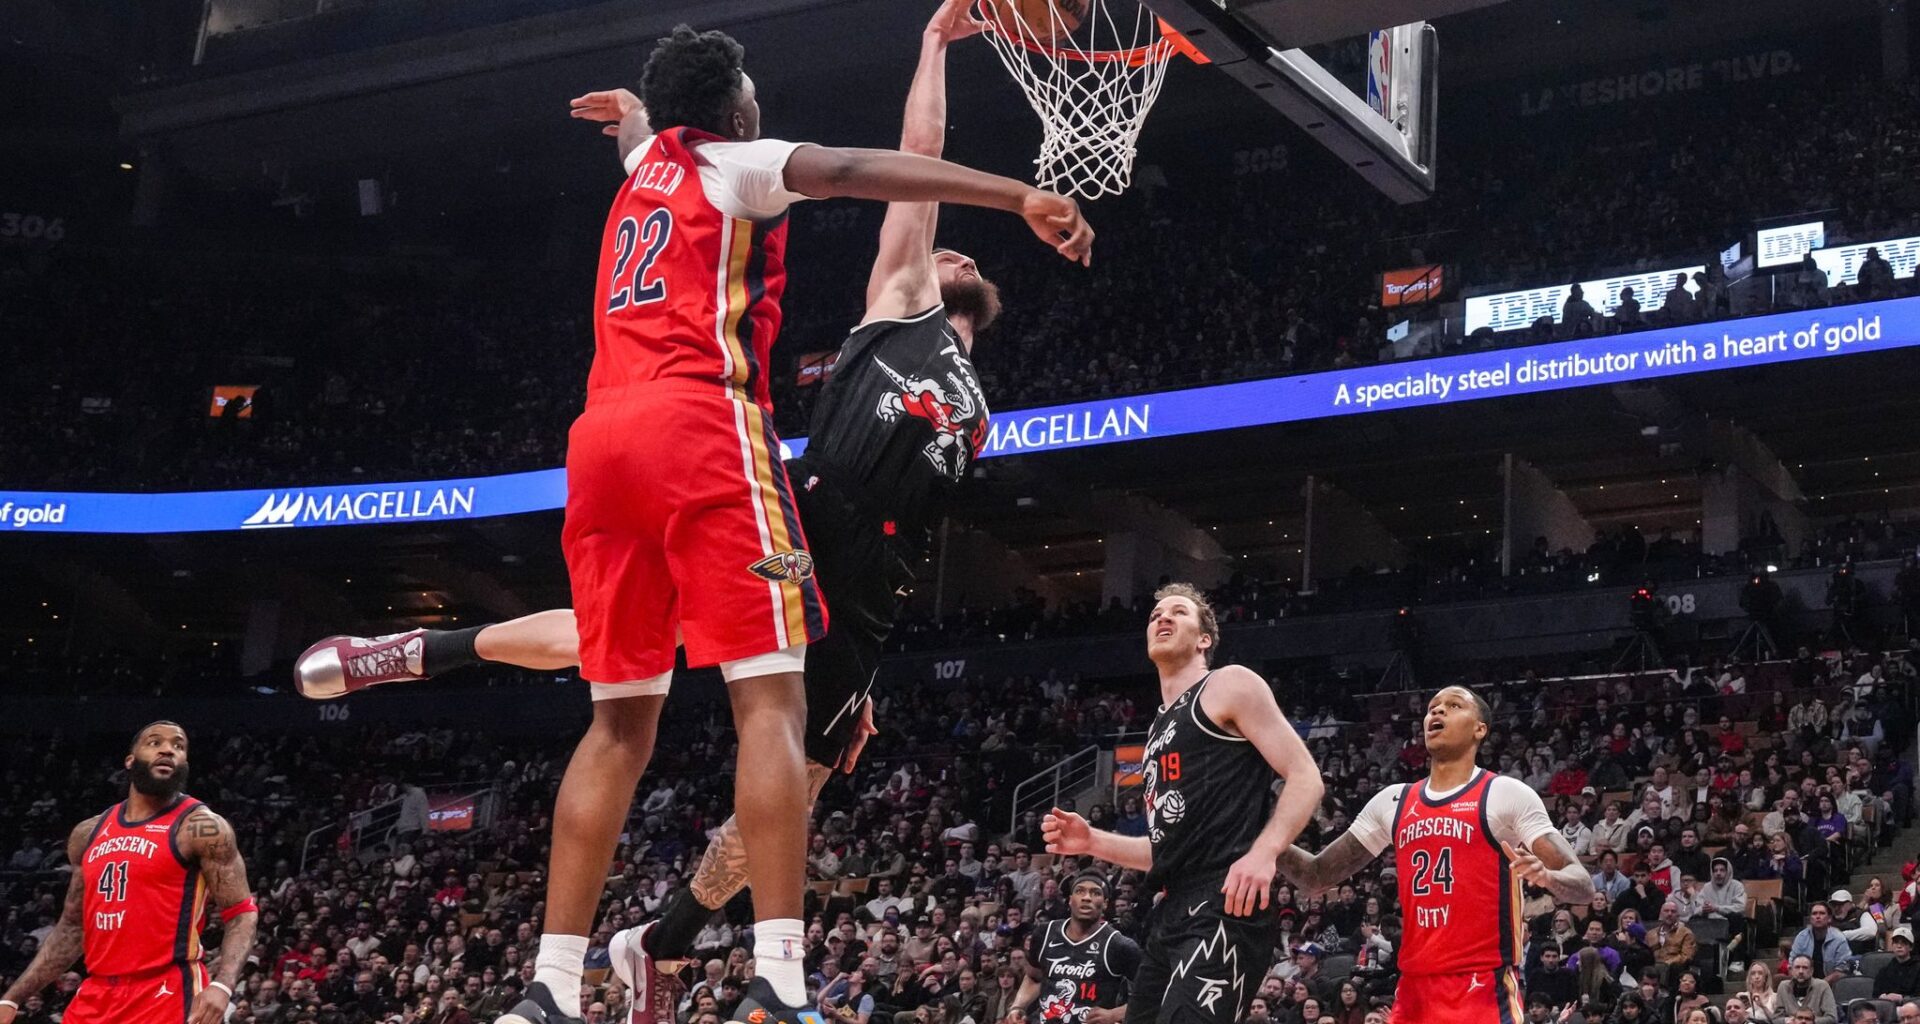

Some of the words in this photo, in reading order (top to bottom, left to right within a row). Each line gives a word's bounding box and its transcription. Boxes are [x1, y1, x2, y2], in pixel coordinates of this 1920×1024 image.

[632, 161, 686, 197] UEEN
[0, 212, 65, 241] 306
[1764, 229, 1817, 260] IBM
[606, 206, 673, 316] 22
[1840, 240, 1920, 283] IM
[1488, 288, 1561, 328] IBM
[1334, 383, 1351, 405] A
[1355, 372, 1453, 408] specialty
[1457, 362, 1510, 391] steel
[1515, 352, 1639, 384] distributor
[1644, 339, 1697, 368] with
[1702, 341, 1717, 361] a
[1723, 329, 1788, 358] heart
[1793, 322, 1820, 350] of
[1823, 315, 1881, 351] gold
[0, 502, 15, 522] f
[13, 503, 66, 527] gold
[303, 487, 474, 522] MAGELLAN
[1668, 593, 1696, 615] 08
[934, 660, 966, 680] 107
[319, 703, 350, 721] 106
[1160, 752, 1181, 782] 19
[1399, 816, 1475, 849] CRESCENT
[88, 835, 158, 864] CRESCENT
[97, 860, 129, 902] 41
[1411, 846, 1455, 897] 24
[95, 910, 126, 931] CITY
[1416, 903, 1450, 928] CITY
[1045, 956, 1096, 980] Toronto
[1079, 982, 1097, 1001] 14
